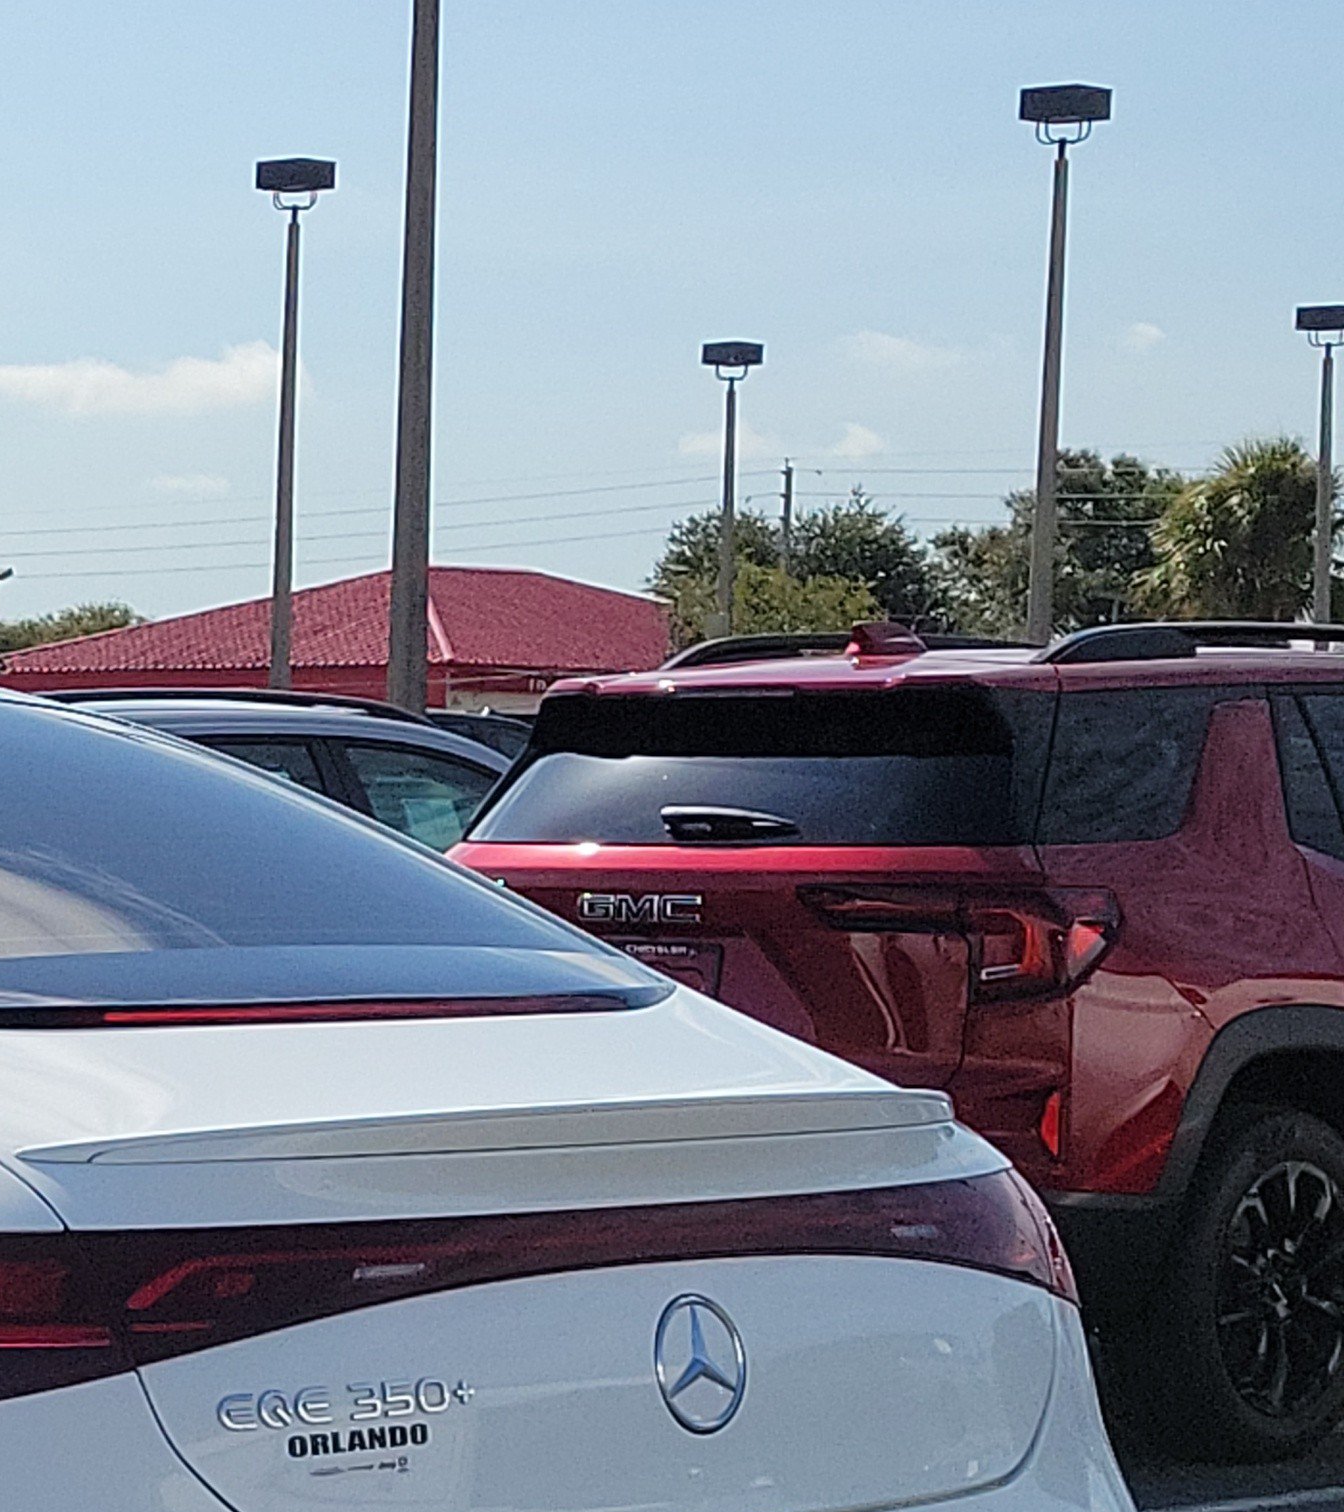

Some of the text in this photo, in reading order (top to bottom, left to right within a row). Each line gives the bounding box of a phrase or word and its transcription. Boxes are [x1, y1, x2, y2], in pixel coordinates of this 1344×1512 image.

[577, 893, 702, 923] GMC
[216, 1376, 476, 1432] EQE 350+
[287, 1423, 429, 1458] ORLANDO
